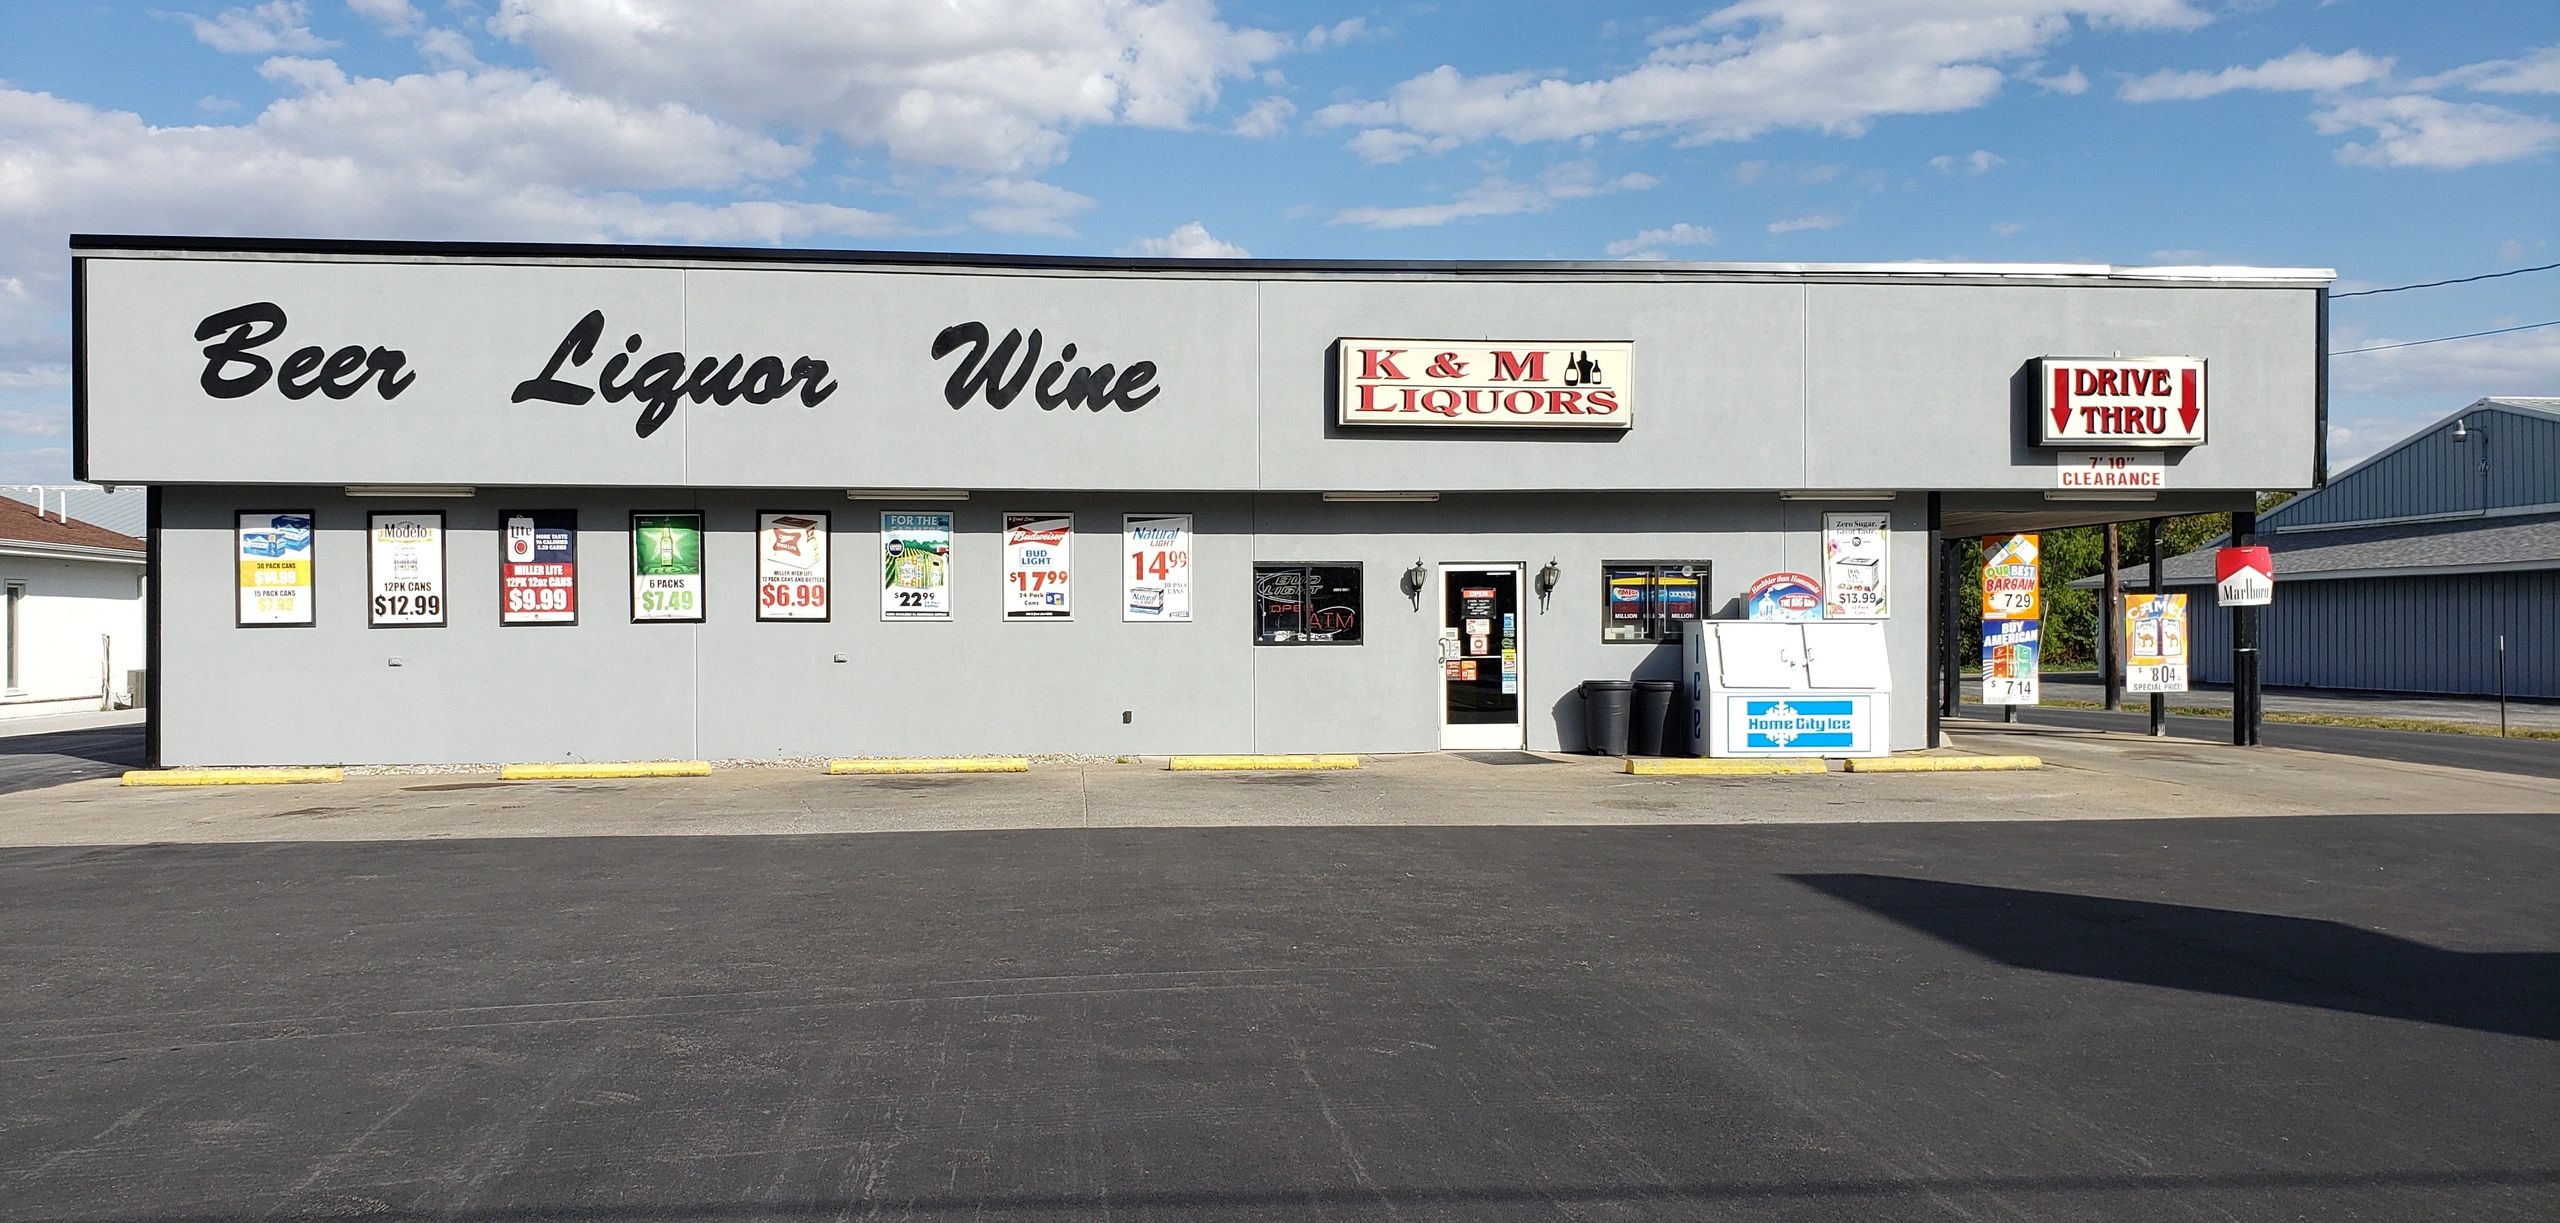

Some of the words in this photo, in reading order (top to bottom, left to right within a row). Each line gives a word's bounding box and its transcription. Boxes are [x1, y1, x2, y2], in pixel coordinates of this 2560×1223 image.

[195, 302, 416, 399] Beer
[511, 310, 838, 438] Liquor
[931, 321, 1160, 412] Wine
[1356, 349, 1410, 379] K
[1425, 352, 1470, 378] &
[1488, 351, 1550, 381] M
[2074, 368, 2173, 396] DRIVE
[1355, 384, 1619, 416] LIQUORS
[2079, 406, 2167, 434] THRU
[2063, 472, 2161, 486] CLEARANCE
[891, 515, 913, 525] FOR
[917, 516, 938, 526] THE
[385, 523, 427, 538] Modelo
[1133, 527, 1180, 540] Natural
[514, 565, 544, 575] MILLER
[545, 565, 563, 575] LITE
[1985, 566, 2009, 578] OUR
[2010, 566, 2036, 578] BEST
[384, 582, 405, 591] 12PK
[408, 582, 432, 591] CANS
[548, 577, 573, 587] CANS
[649, 579, 655, 588] 6
[657, 579, 684, 588] PACKS
[1985, 579, 2036, 592] BARGAIN
[2224, 578, 2269, 600] Marlboro
[509, 588, 567, 611] $9.99
[642, 590, 693, 612] $7.49
[762, 583, 824, 608] $6.99
[1839, 593, 1876, 604] $13.99
[375, 594, 440, 617] $12.99
[1310, 612, 1354, 628] ATM
[2001, 621, 2024, 634] BUY
[1984, 629, 2038, 647] AMERICAN
[1749, 718, 1793, 729] Home
[1796, 718, 1825, 731] City
[1828, 718, 1850, 729] Ice
